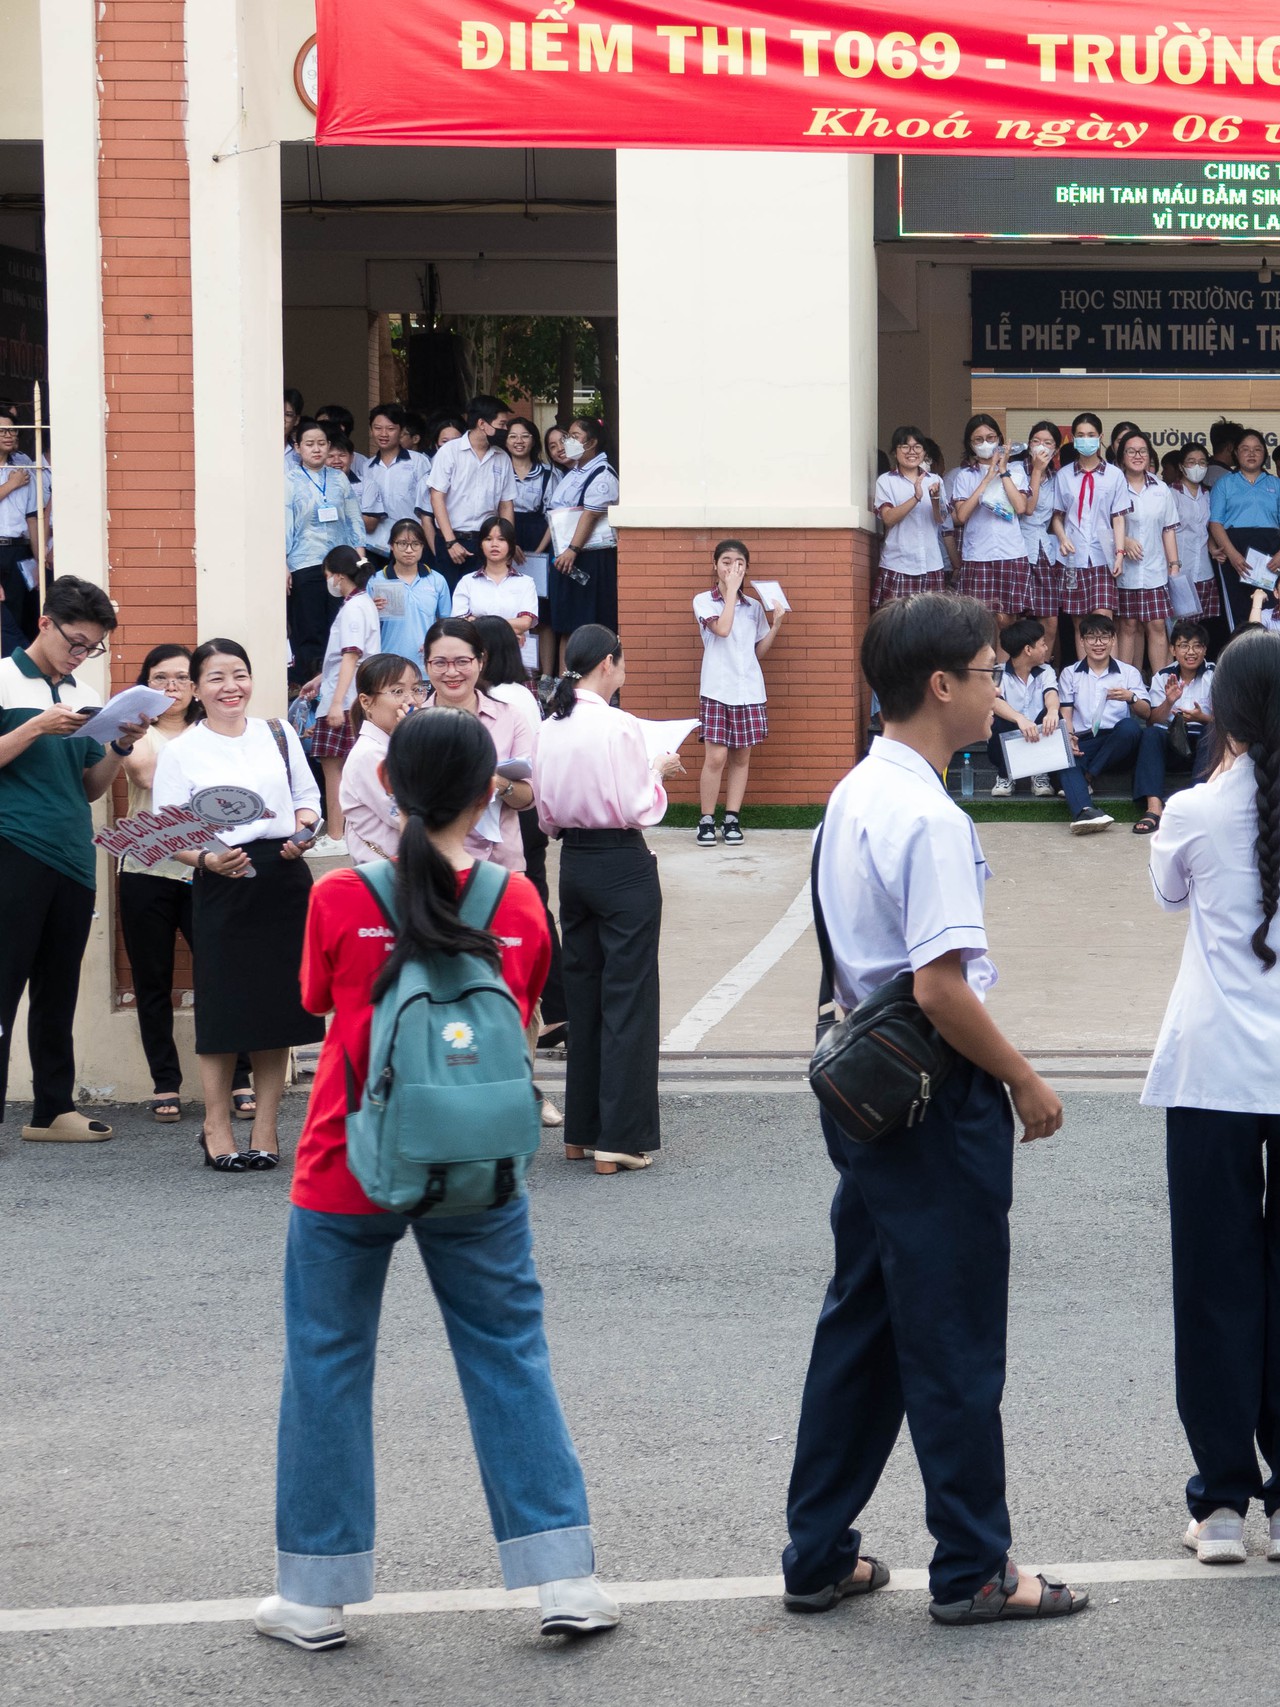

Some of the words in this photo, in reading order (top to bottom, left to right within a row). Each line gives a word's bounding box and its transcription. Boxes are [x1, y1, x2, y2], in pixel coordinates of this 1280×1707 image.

[458, 0, 632, 72] ĐIỂM
[657, 26, 767, 75] THI
[790, 30, 960, 79] T069
[985, 59, 1006, 69] -
[804, 108, 971, 138] Khoá
[996, 114, 1148, 147] ngày
[1173, 115, 1242, 142] 06
[1204, 164, 1269, 180] CHUNG
[1057, 184, 1104, 206] BỆNH
[1110, 187, 1147, 203] TAN
[1153, 183, 1197, 204] MÁU
[1153, 208, 1172, 229] VÌ
[1178, 212, 1248, 229] TƯƠNG
[1060, 289, 1104, 312] HỌC
[1113, 290, 1161, 309] SINH
[1169, 286, 1254, 310] TRƯỜNG
[985, 311, 1012, 350] LỄ
[1021, 317, 1081, 350] PHÉP
[1101, 319, 1160, 350] THÂN
[1168, 319, 1234, 356] THIỆN
[138, 811, 178, 831] Cha
[131, 843, 169, 867] Luôn
[156, 834, 191, 853] bên
[187, 829, 215, 844] em
